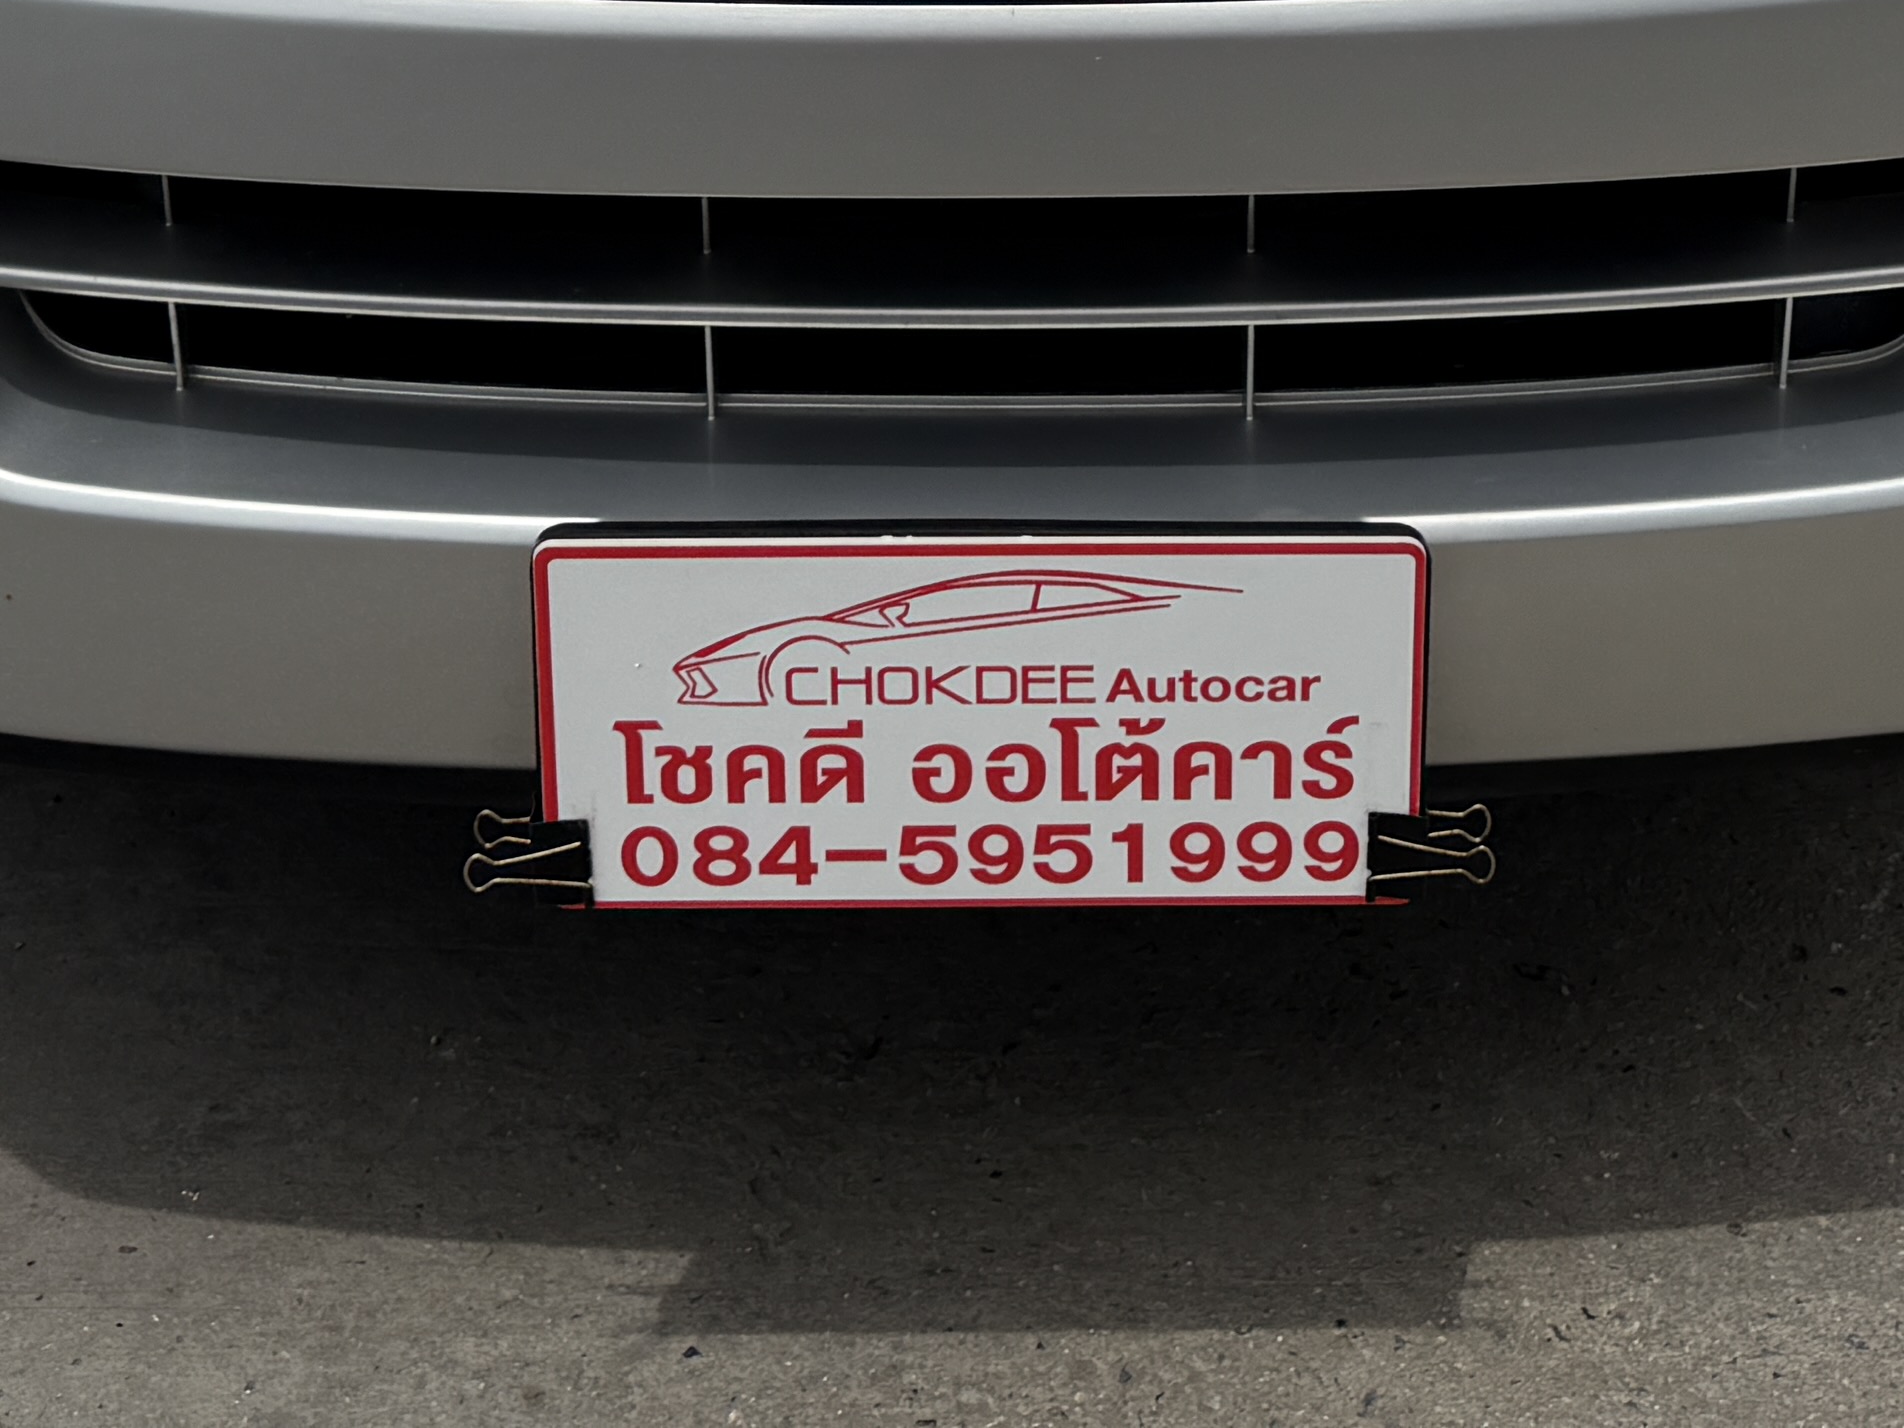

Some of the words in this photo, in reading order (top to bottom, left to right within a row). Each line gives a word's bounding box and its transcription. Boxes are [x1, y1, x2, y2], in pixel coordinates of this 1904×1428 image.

[783, 664, 1096, 707] CHOKDEE
[1104, 668, 1321, 705] Autocar
[613, 719, 866, 806] โชคดี
[910, 716, 1361, 805] ออโต้คาร์
[620, 821, 1362, 888] 084-5951999
